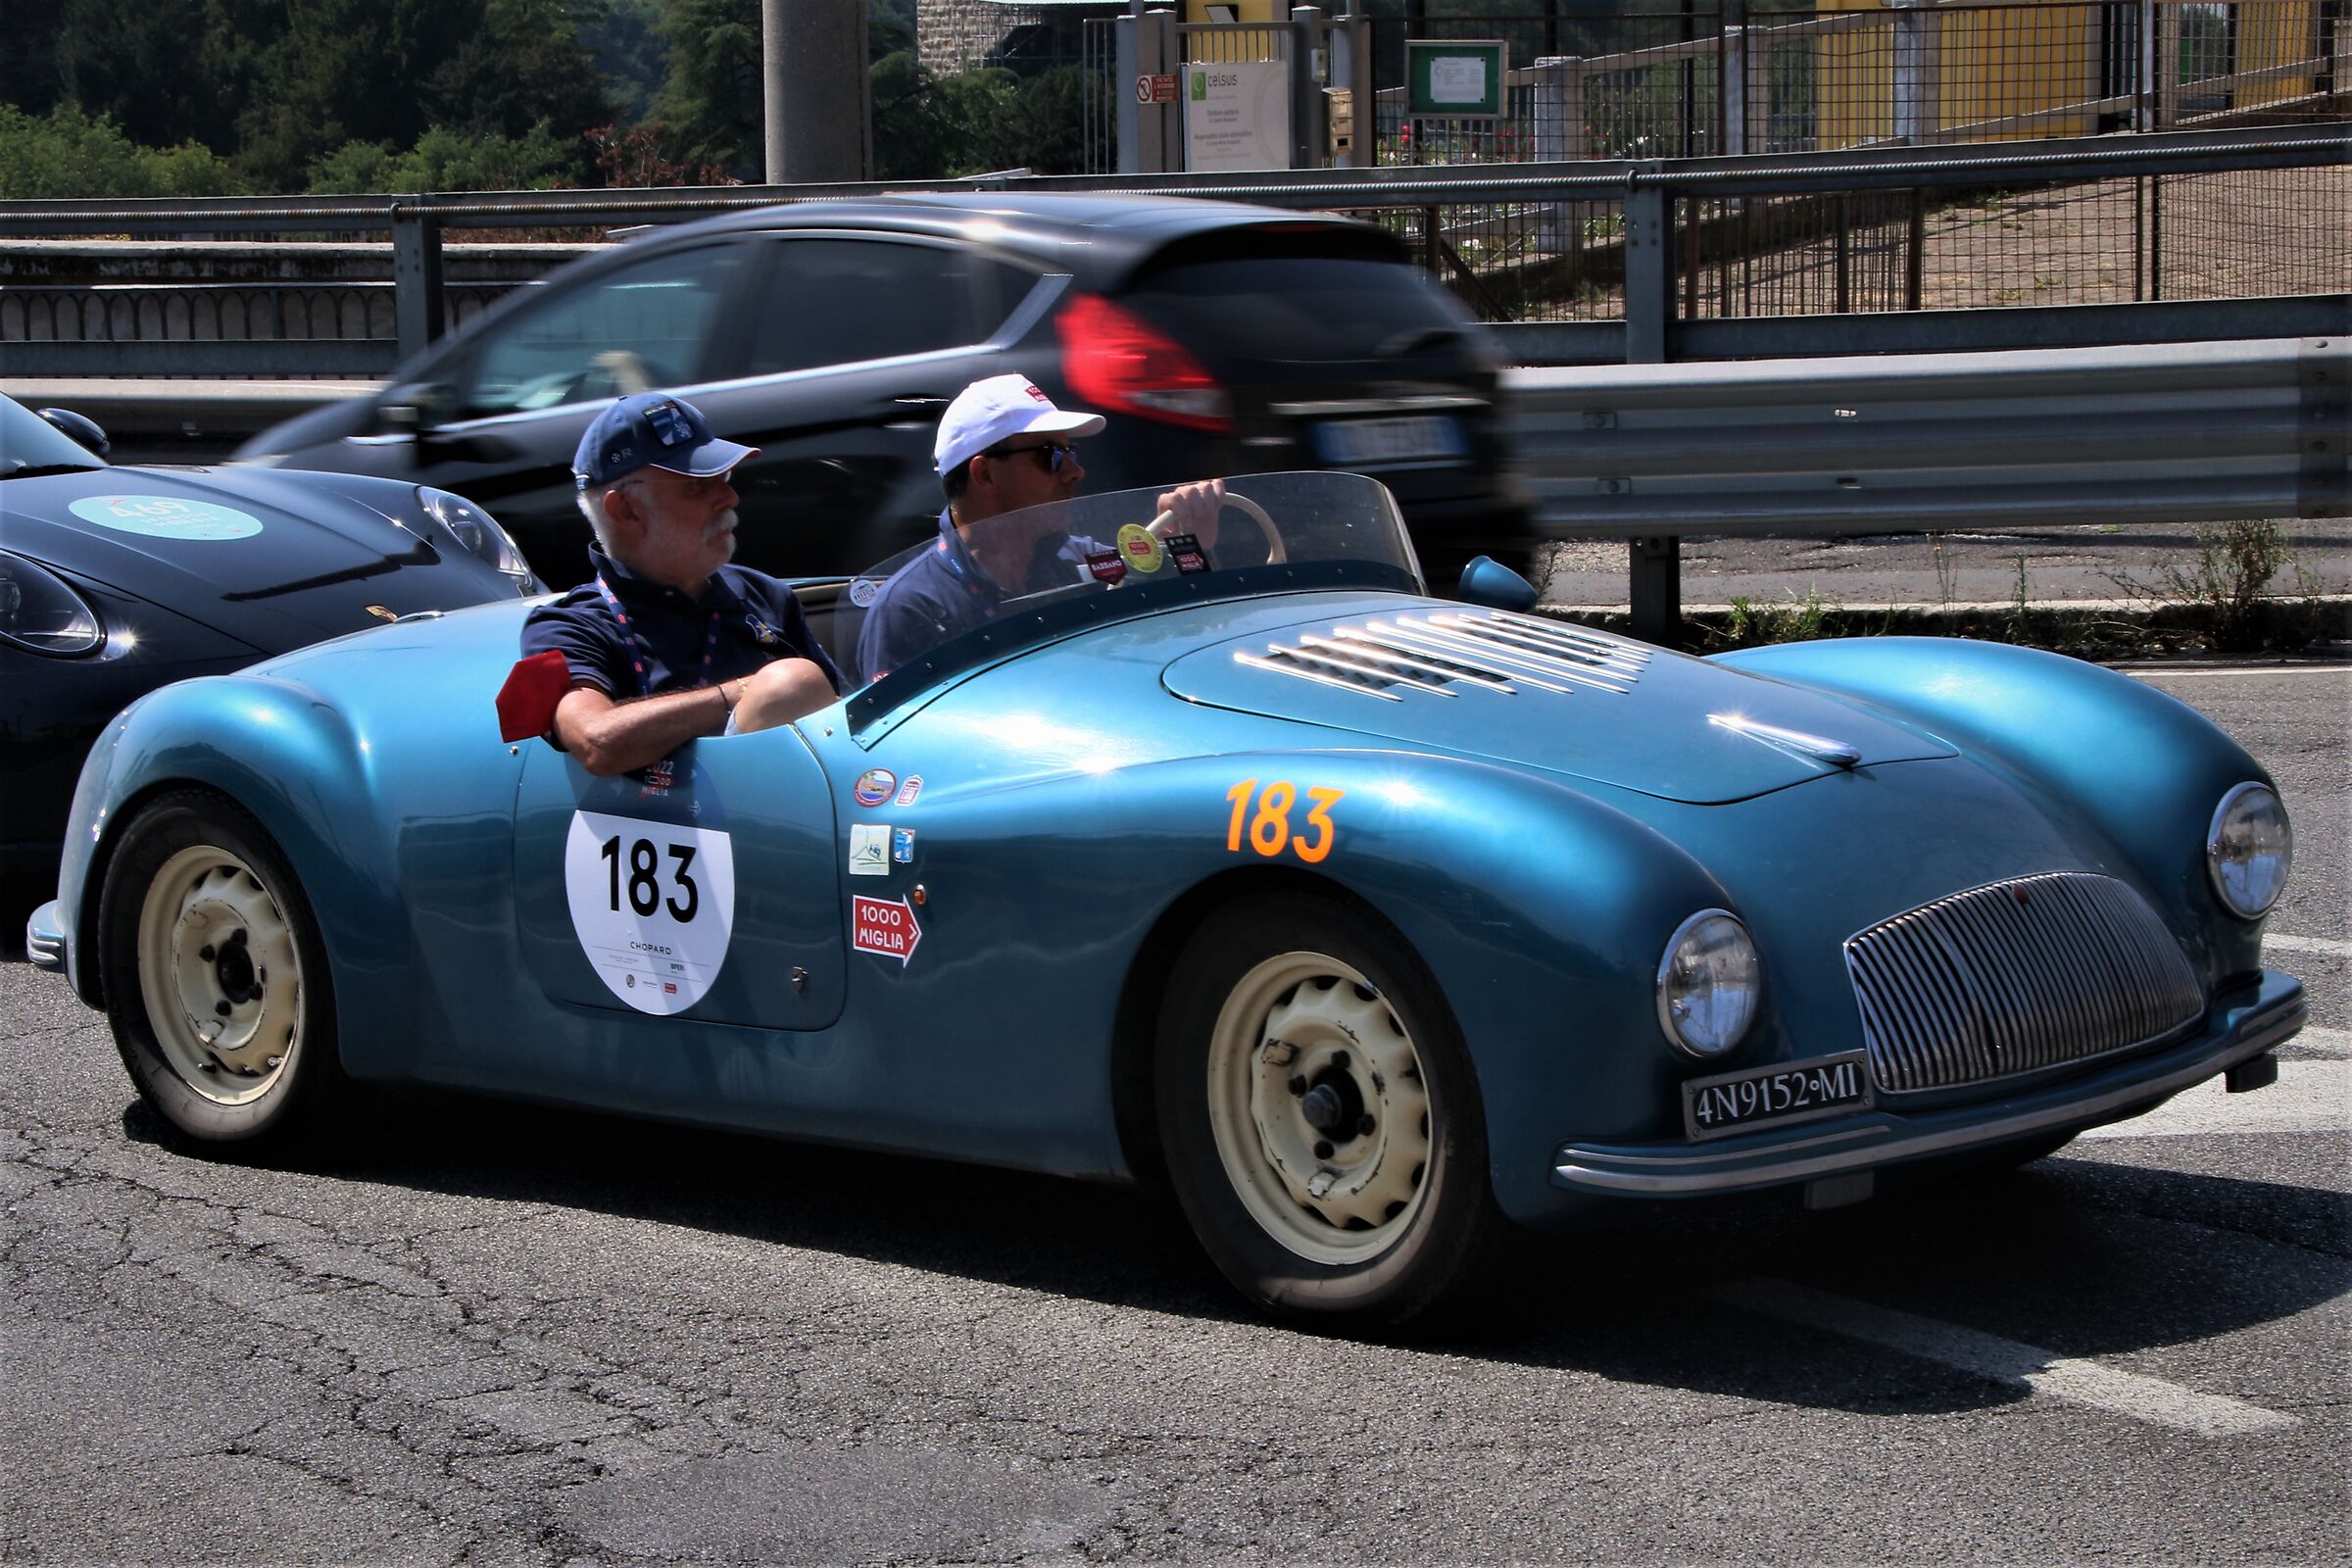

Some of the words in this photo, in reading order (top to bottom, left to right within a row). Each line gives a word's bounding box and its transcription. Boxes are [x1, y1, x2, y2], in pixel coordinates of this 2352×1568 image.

[1207, 73, 1237, 87] celsus
[108, 500, 190, 517] 469
[1091, 560, 1123, 571] BASSANO
[1226, 778, 1346, 863] 183
[602, 835, 699, 923] 183
[861, 905, 901, 926] 1000
[858, 927, 904, 950] MIGLIA
[629, 941, 672, 956] CHOPARD
